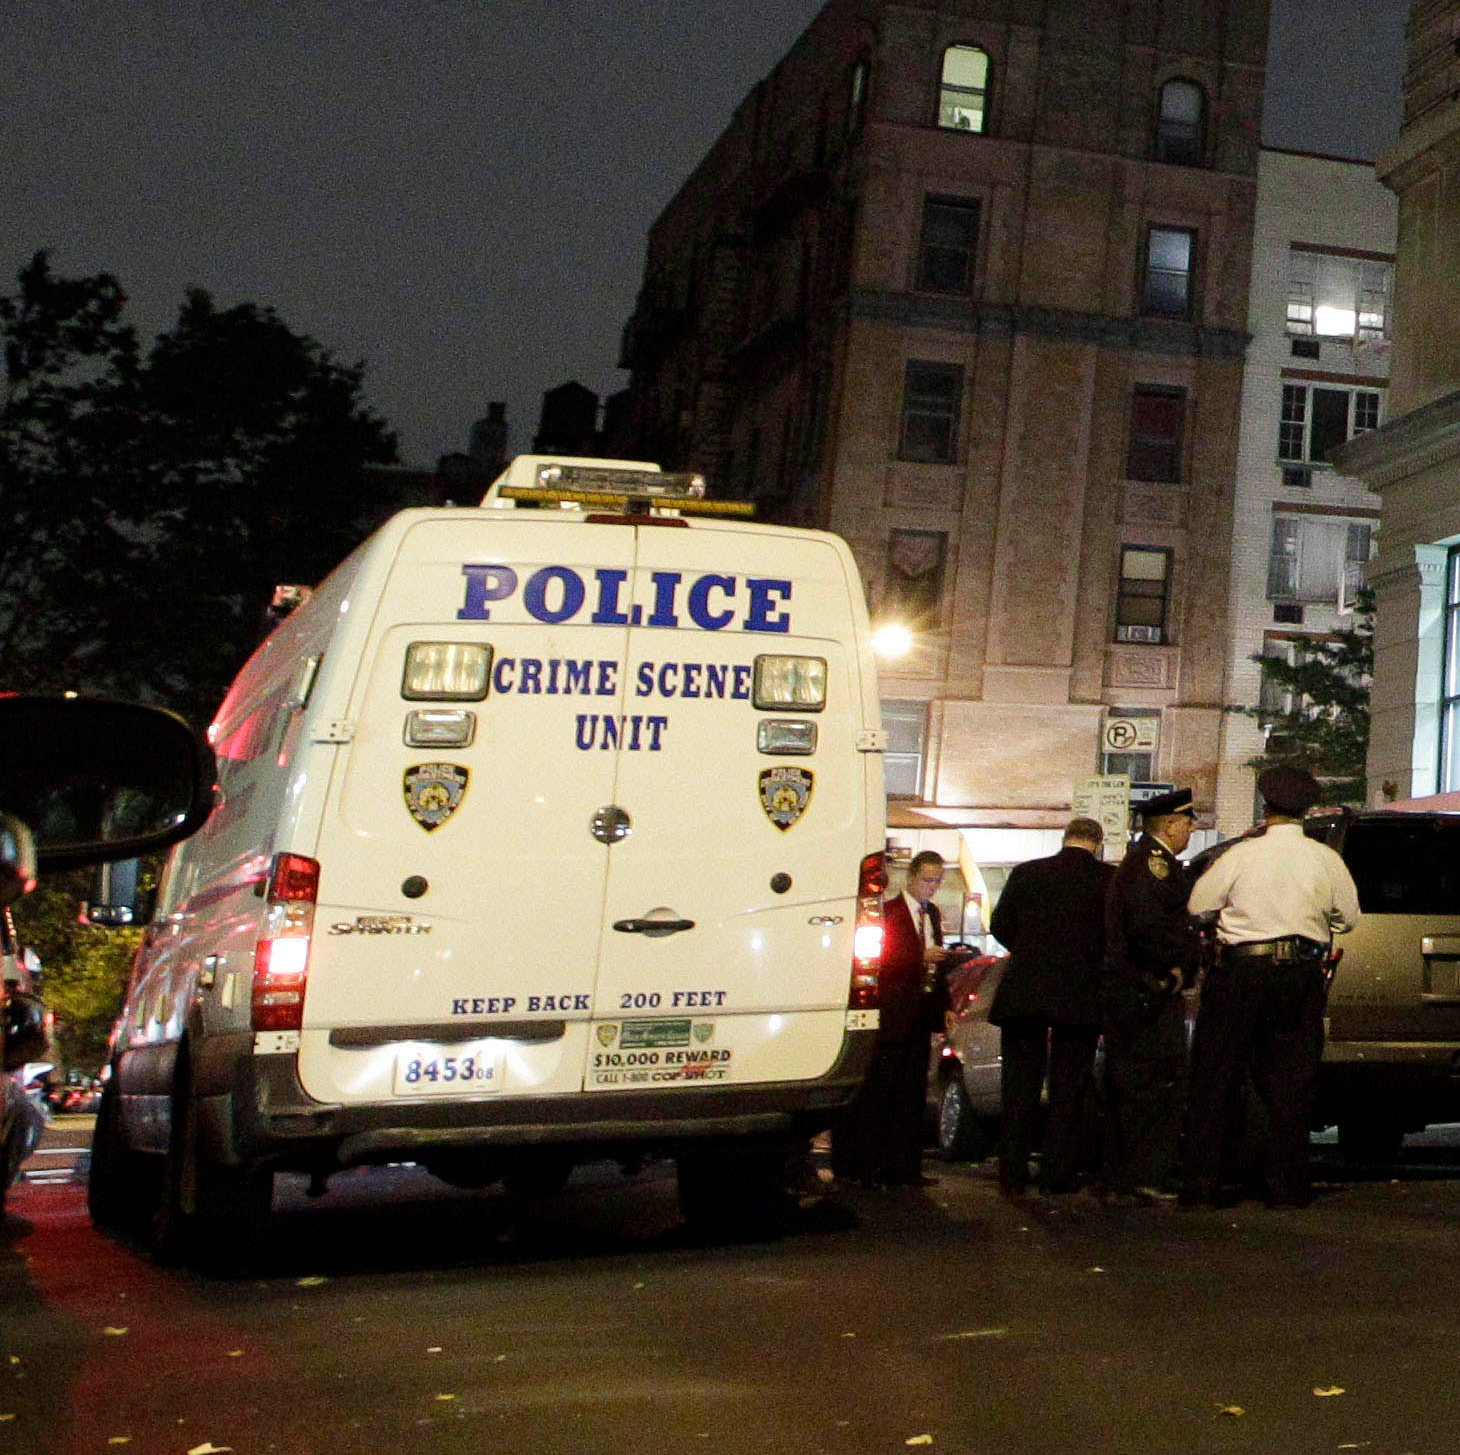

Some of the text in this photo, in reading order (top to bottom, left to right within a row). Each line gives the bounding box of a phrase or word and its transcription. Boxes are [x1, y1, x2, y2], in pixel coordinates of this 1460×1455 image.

[457, 564, 792, 633] POLICE
[493, 657, 751, 699] CRIME SCENE
[575, 714, 668, 751] UNIT
[451, 991, 727, 1015] KEEP BACK 200 FEET
[665, 1050, 731, 1063] REWARD
[405, 1057, 475, 1083] 8453
[596, 1073, 618, 1083] CALL
